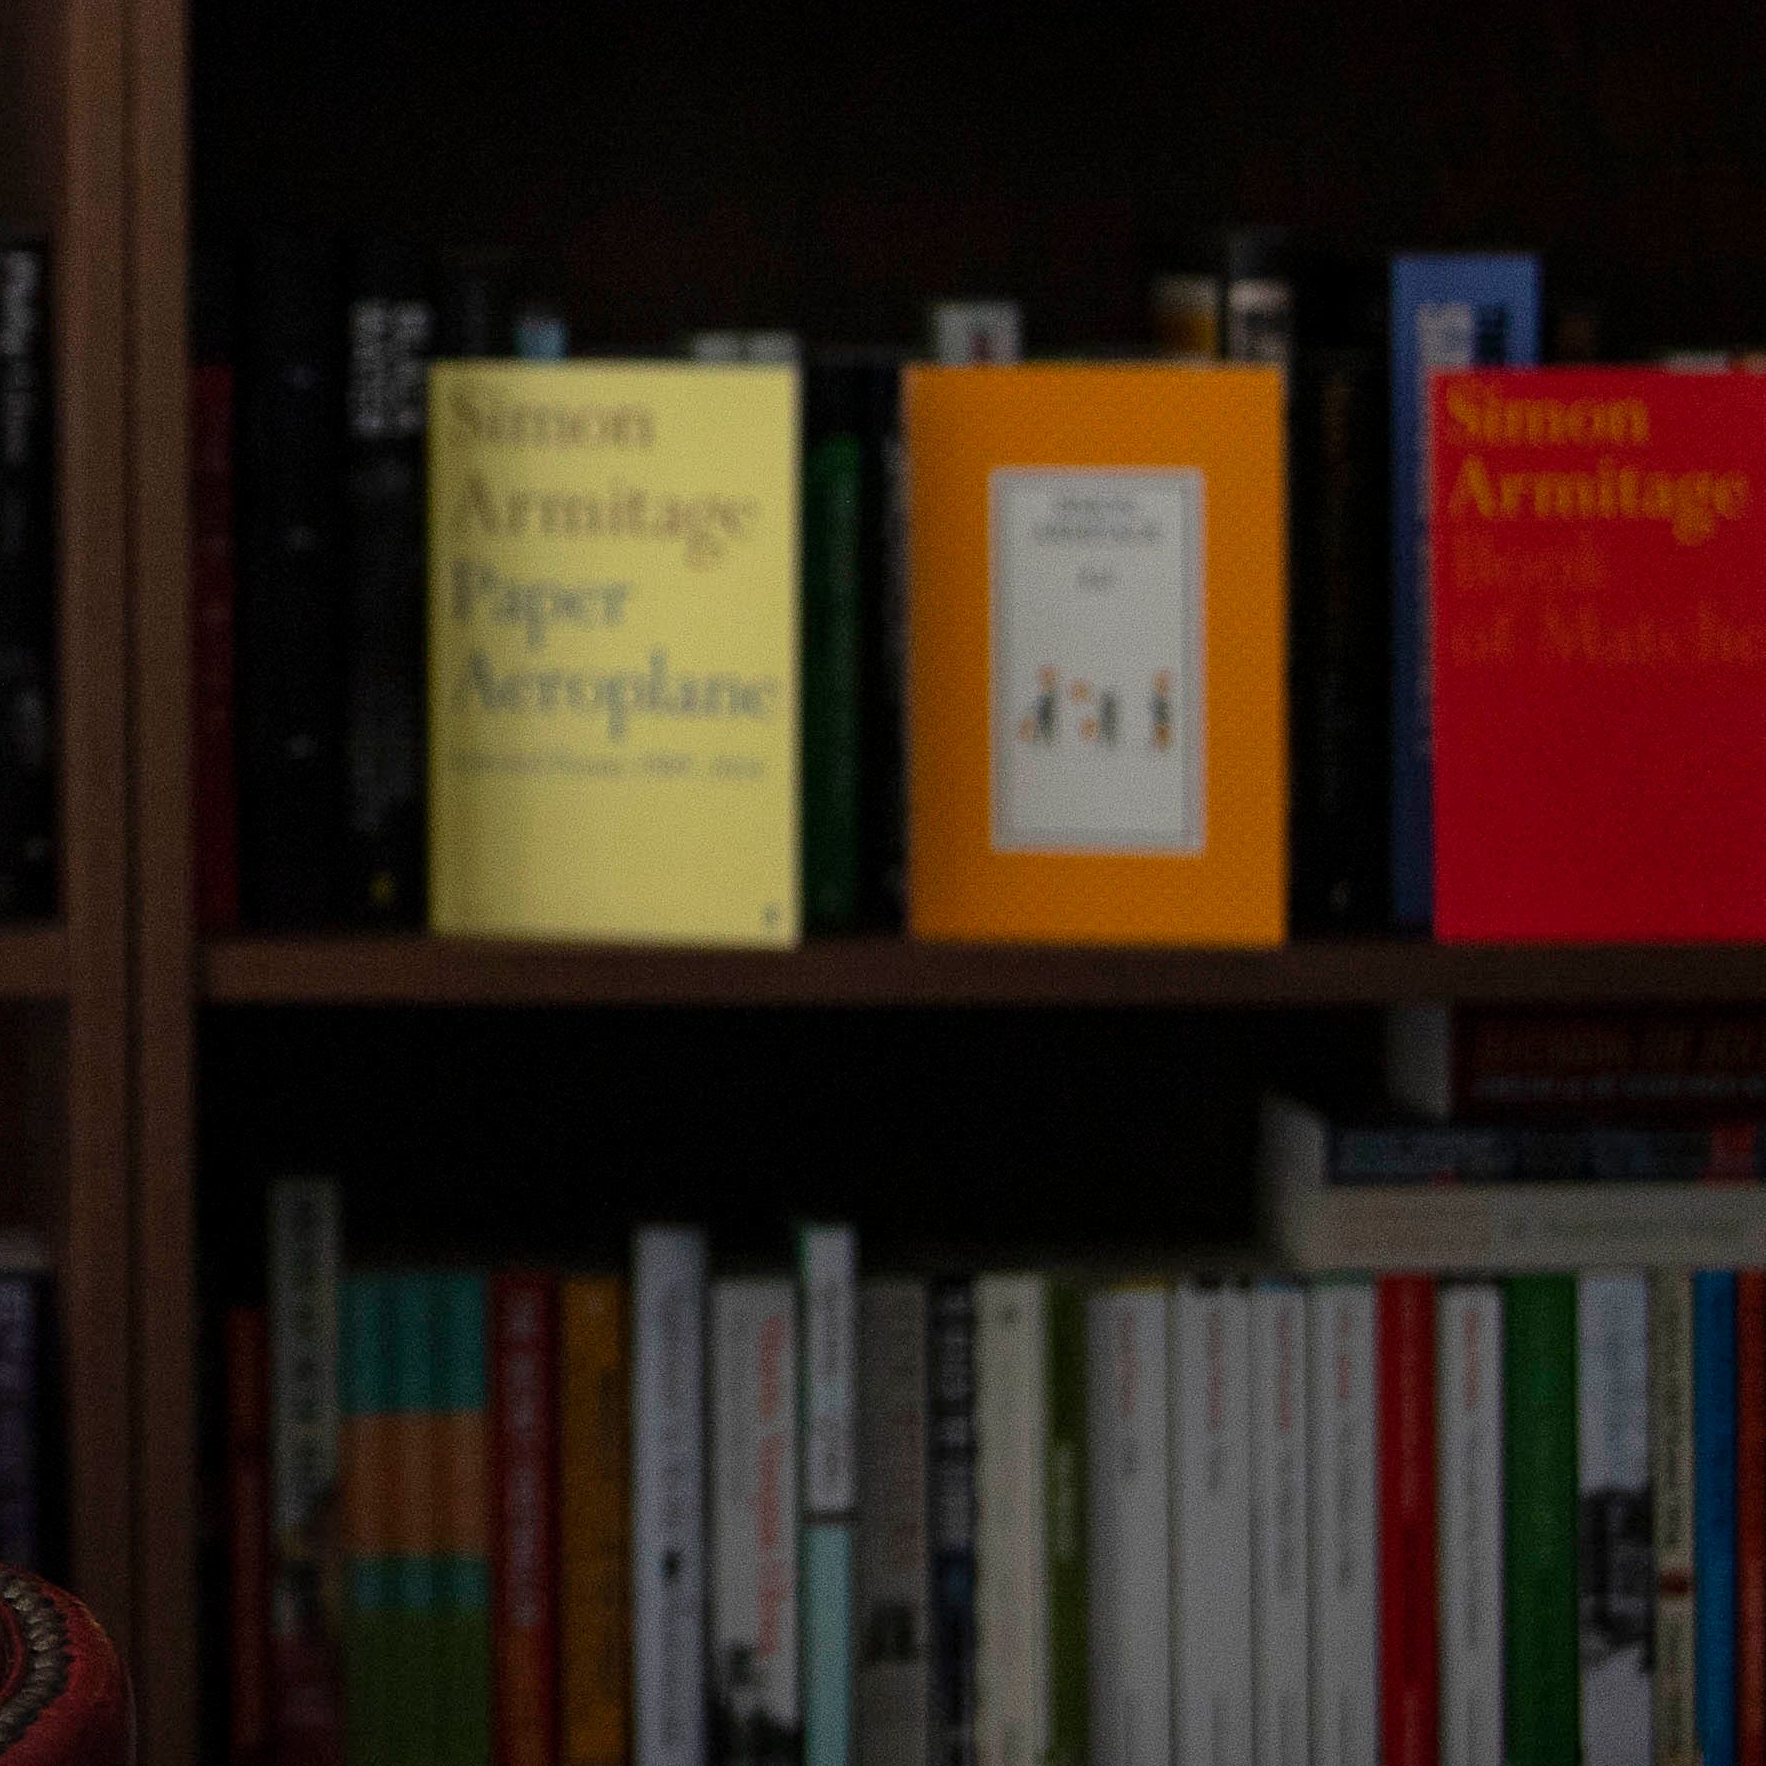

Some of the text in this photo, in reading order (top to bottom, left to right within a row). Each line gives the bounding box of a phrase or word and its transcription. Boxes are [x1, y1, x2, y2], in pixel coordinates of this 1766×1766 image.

[447, 390, 657, 452] Simon
[1446, 379, 1651, 446] Simon
[448, 474, 763, 572] Armitage
[1448, 458, 1751, 546] Armitage
[451, 556, 640, 652] Paper
[1538, 604, 1766, 666] Matche
[448, 649, 784, 746] Aeroplane
